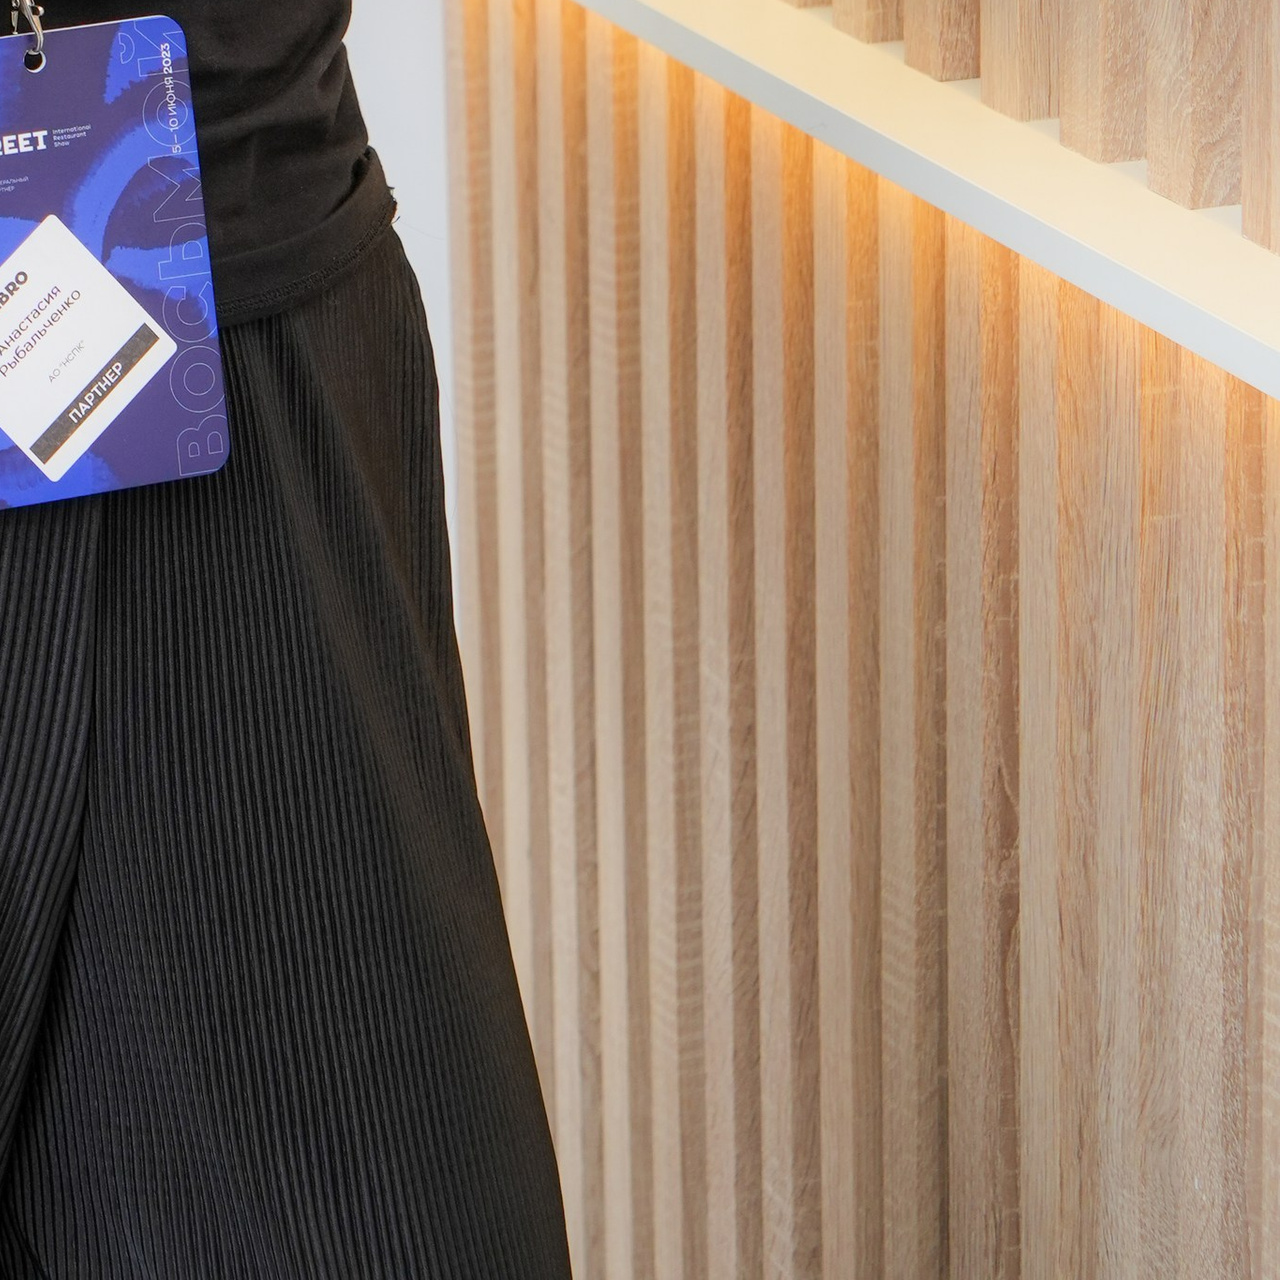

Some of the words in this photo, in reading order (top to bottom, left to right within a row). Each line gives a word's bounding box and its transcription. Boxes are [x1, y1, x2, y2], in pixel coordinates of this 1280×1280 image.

[160, 42, 174, 74] 2023
[164, 76, 178, 117] ИЮНЯ
[52, 123, 92, 135] International
[170, 118, 179, 132] 10
[53, 131, 87, 141] Restaurant
[54, 140, 70, 148] Show
[172, 144, 182, 153] 5
[48, 368, 61, 383] АО
[68, 361, 123, 424] ПАРТНЕР
